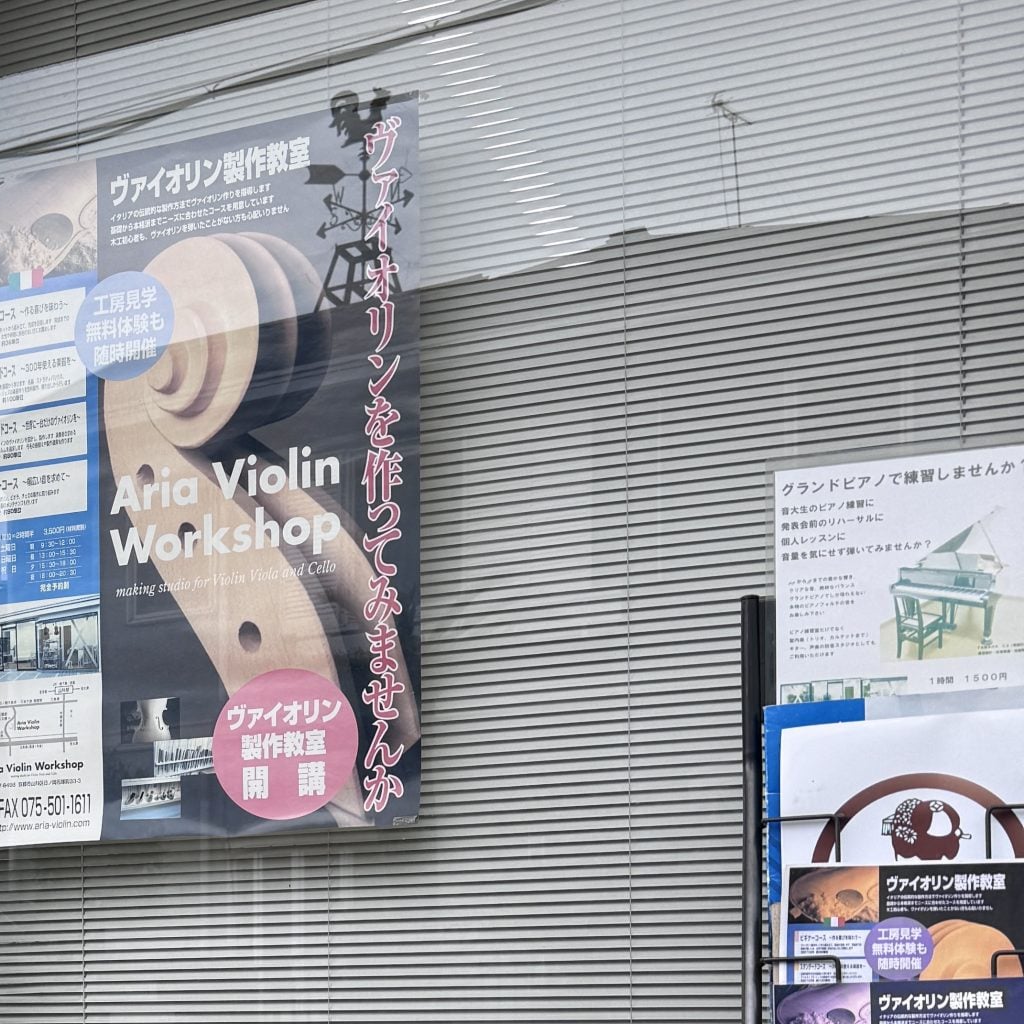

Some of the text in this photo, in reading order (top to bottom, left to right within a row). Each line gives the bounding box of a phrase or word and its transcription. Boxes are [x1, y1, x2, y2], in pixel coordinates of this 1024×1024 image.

[110, 136, 311, 206] ヴァイオリン製作教室
[94, 287, 157, 316] 工房見学
[85, 311, 165, 344] 無料体験も
[93, 339, 158, 368] 随時開催
[361, 115, 405, 813] ヴァイオリンを作ってみませんか
[110, 467, 198, 515] Aria
[212, 445, 340, 500] Violin
[781, 499, 874, 516] 音大生のピアノ練習に
[781, 513, 884, 532] 発表会前のリハーサルに
[110, 506, 342, 567] Workshop
[781, 532, 846, 547] 個人レッスンに
[115, 558, 337, 598] making studio for Violin Viola and Cello
[965, 672, 1007, 683] 1500円
[226, 698, 342, 730] ヴァイオリン
[241, 730, 327, 760] 製作教室
[6, 763, 32, 773] Violin
[34, 759, 84, 772] Workshop
[21, 793, 91, 818] 075-501-1611
[886, 873, 1006, 892] ヴァイオリン製作教室
[878, 928, 922, 941] 工房見学
[872, 942, 927, 956] 無料体験も
[878, 957, 922, 971] 随時開催
[879, 991, 1004, 1011] ヴァイオリン製作教室
